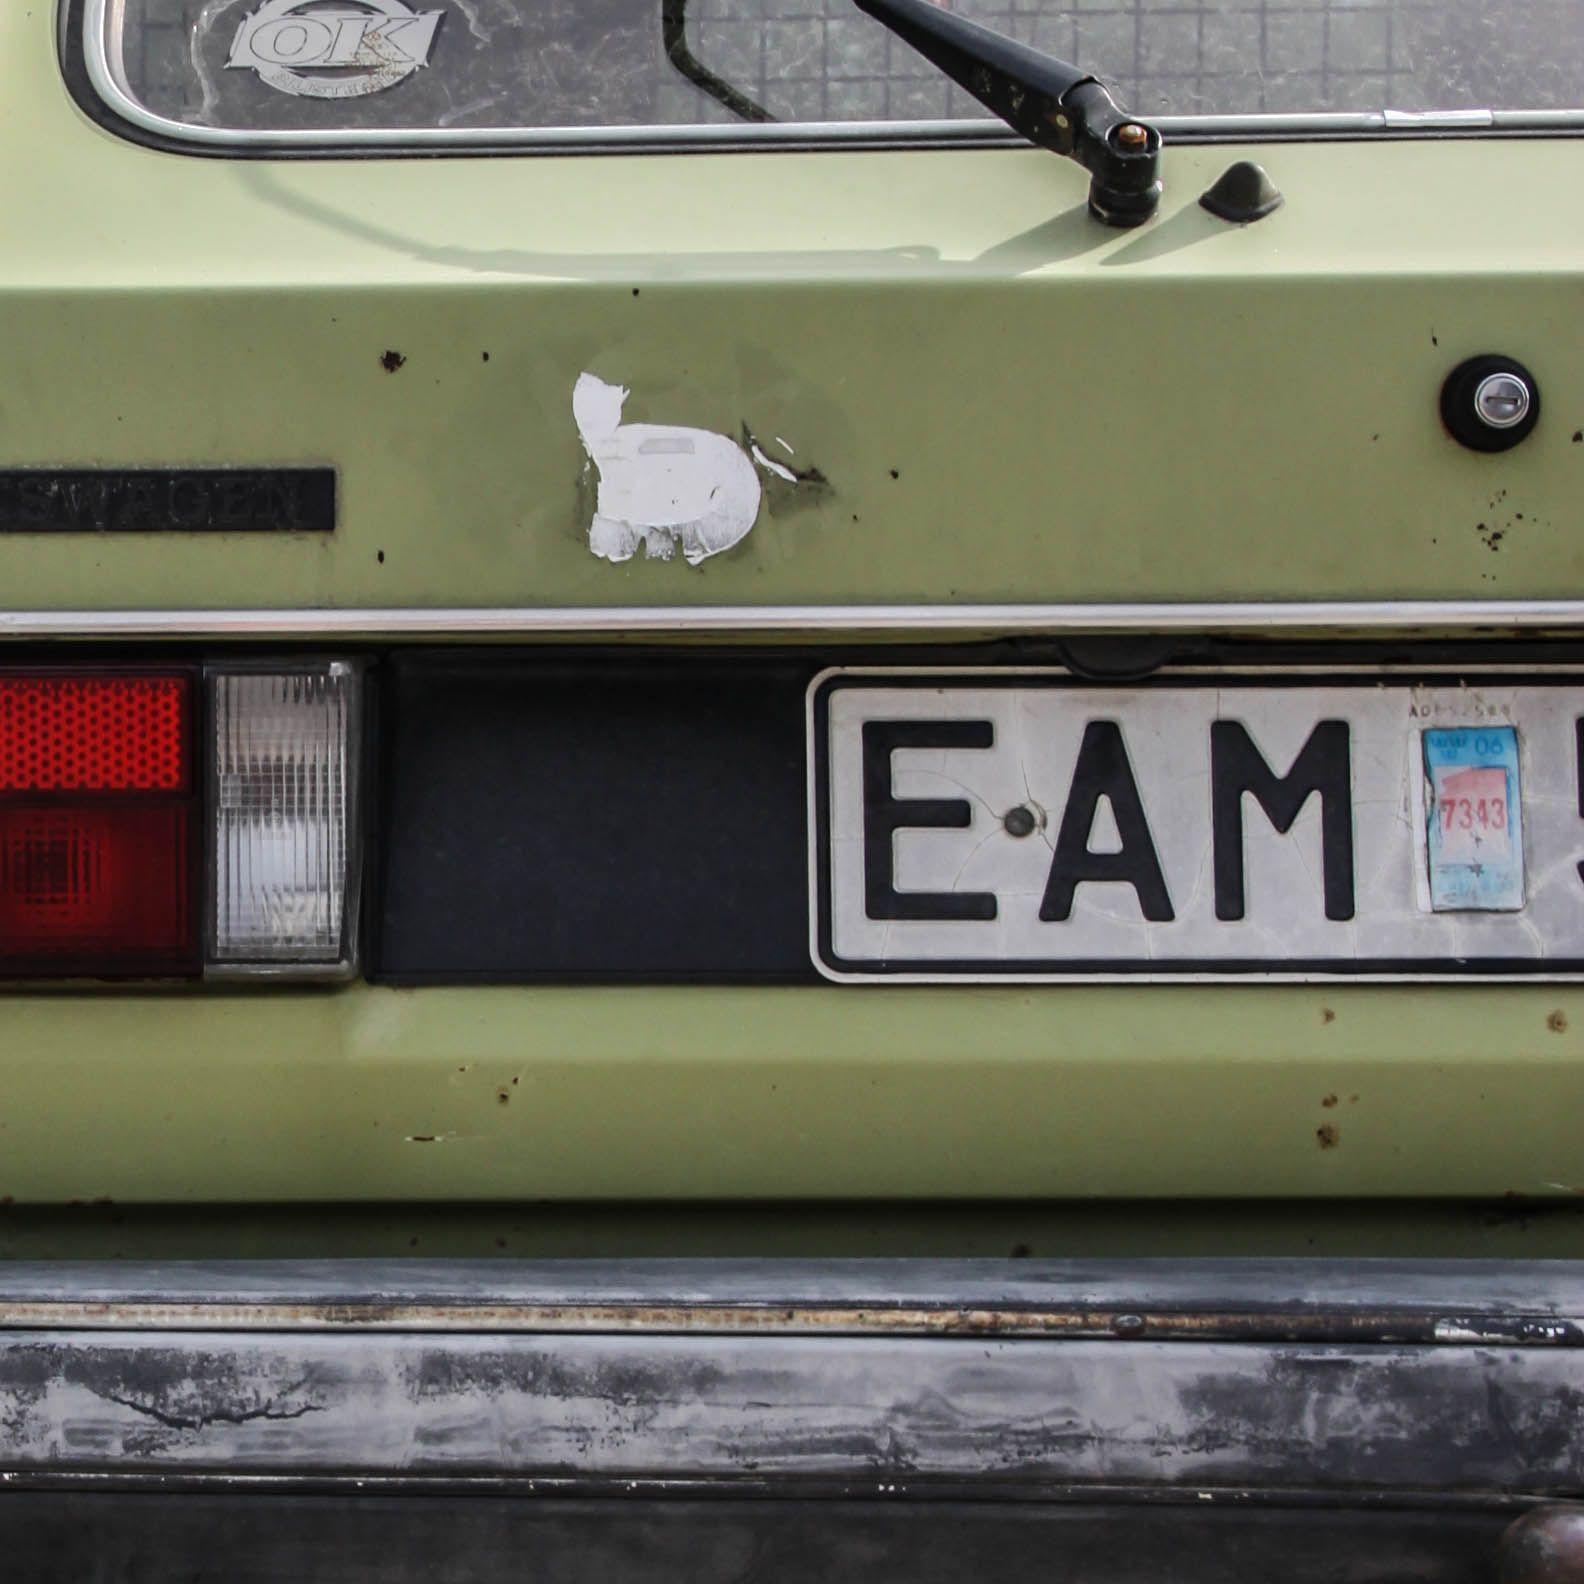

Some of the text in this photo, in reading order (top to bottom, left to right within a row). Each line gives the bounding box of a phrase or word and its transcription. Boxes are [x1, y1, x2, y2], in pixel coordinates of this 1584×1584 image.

[249, 17, 420, 64] OK
[862, 720, 1355, 922] EAM
[1440, 797, 1506, 830] 7343
